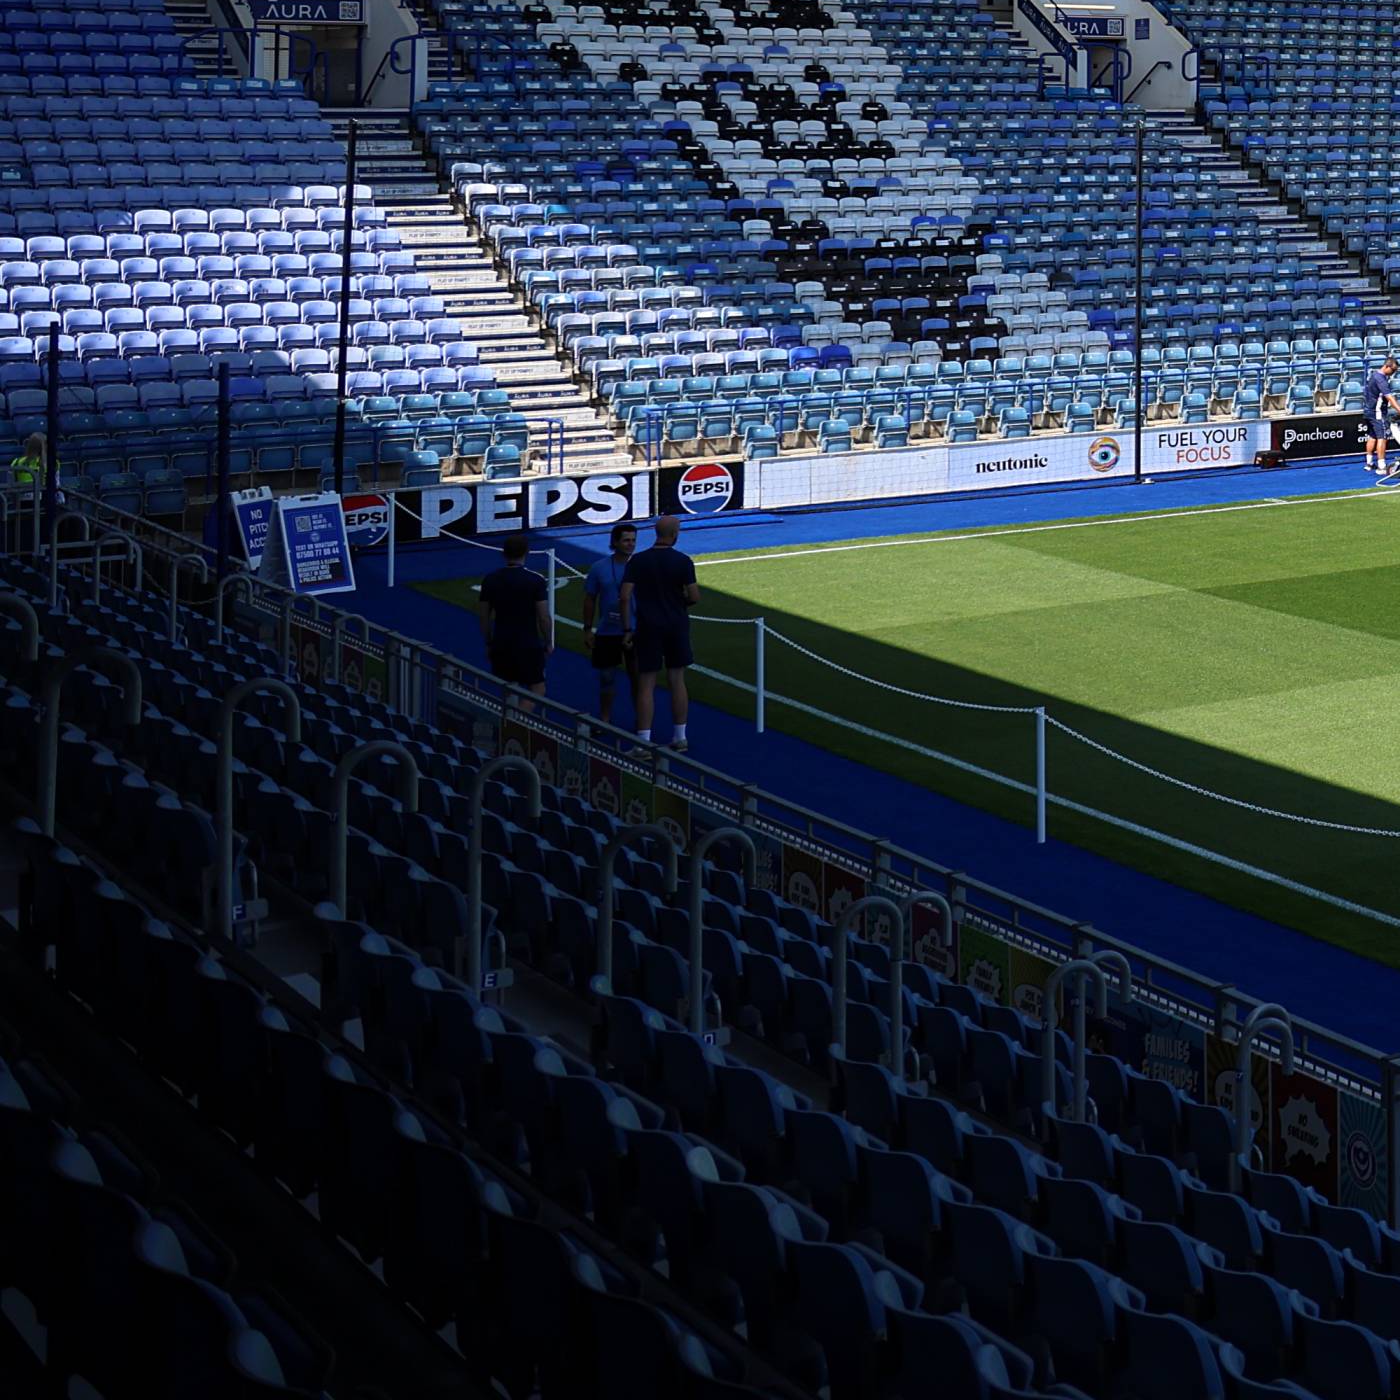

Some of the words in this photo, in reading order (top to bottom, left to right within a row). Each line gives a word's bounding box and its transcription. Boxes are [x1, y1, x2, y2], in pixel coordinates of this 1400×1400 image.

[1158, 432, 1202, 448] FUEL
[1204, 427, 1248, 444] YOUR
[1283, 428, 1344, 450] Panchaea
[975, 453, 1049, 473] neutonic
[1176, 445, 1231, 464] FOCUS
[682, 482, 730, 497] PEPSI
[250, 508, 262, 520] NO
[421, 473, 652, 538] PEPSI
[345, 511, 388, 527] EPSI
[249, 521, 268, 536] PITC
[484, 973, 497, 987] E
